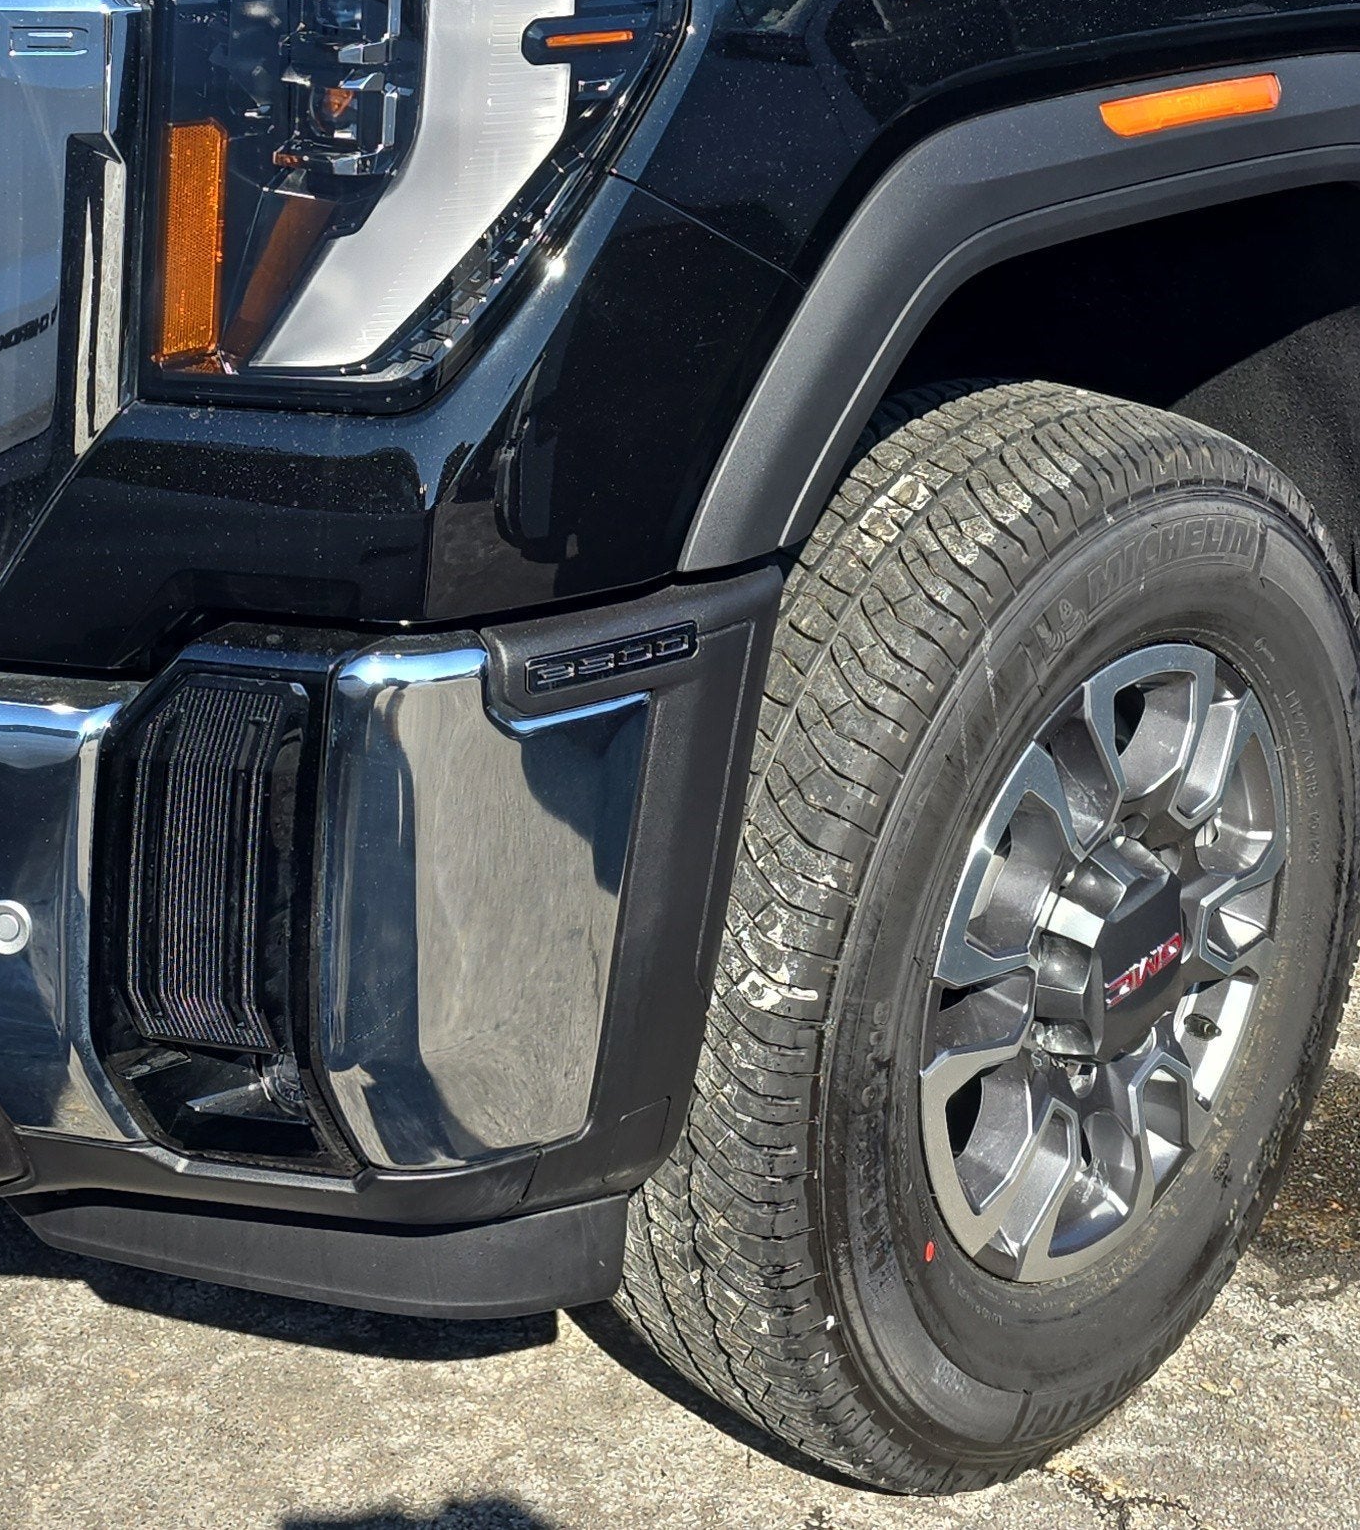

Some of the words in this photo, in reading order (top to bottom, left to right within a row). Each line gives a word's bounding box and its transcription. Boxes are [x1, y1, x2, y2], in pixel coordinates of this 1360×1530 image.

[1087, 516, 1259, 611] MICHELIN
[536, 633, 690, 686] 2500
[1103, 931, 1184, 1011] GMC
